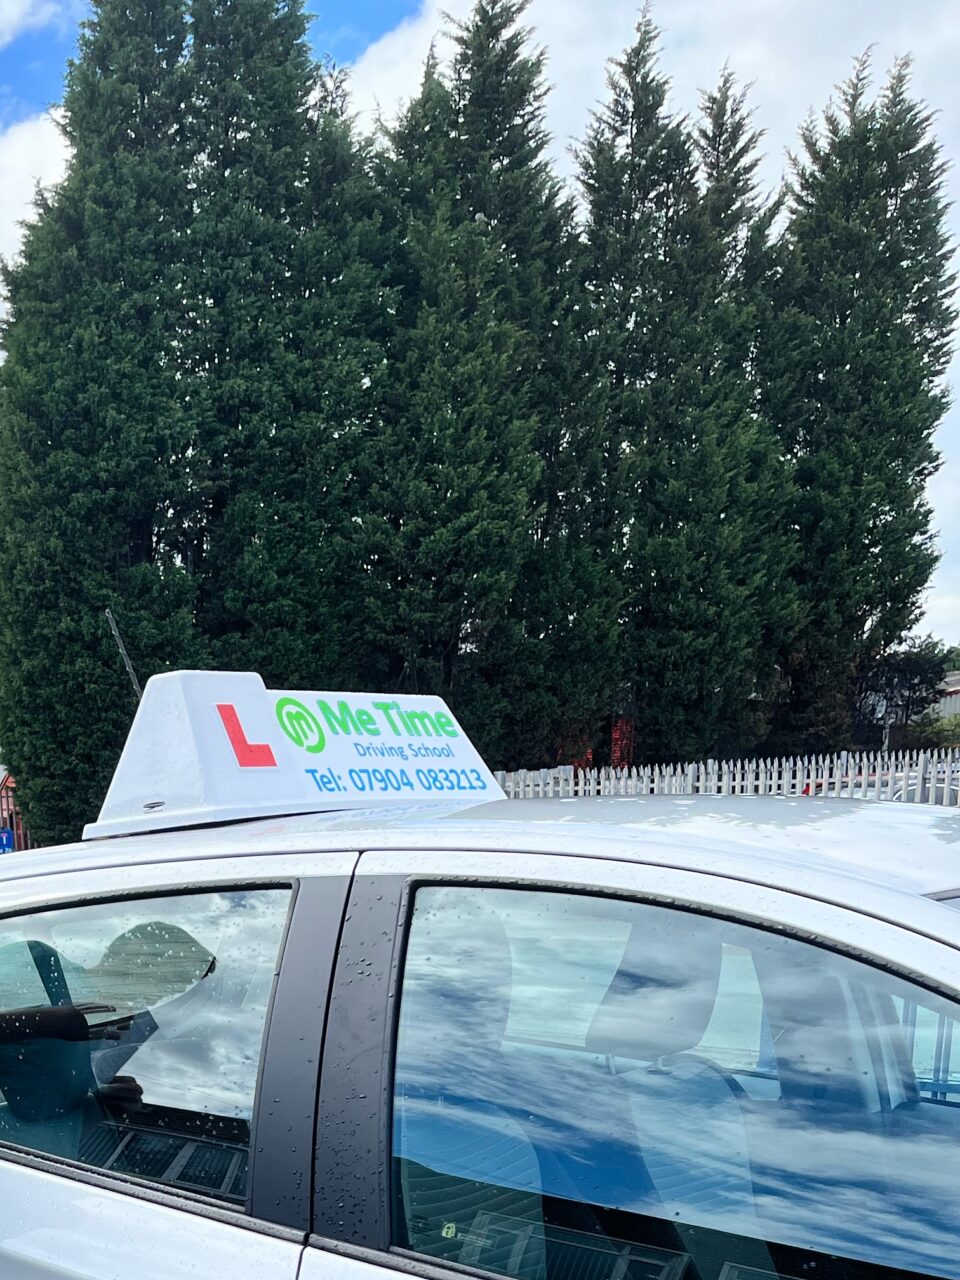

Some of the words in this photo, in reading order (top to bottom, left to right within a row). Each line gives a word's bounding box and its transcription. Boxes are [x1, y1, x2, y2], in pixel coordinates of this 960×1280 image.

[316, 699, 377, 736] Me
[373, 701, 459, 738] Time
[216, 703, 278, 767] L
[353, 742, 409, 761] Driving
[411, 743, 455, 758] School
[305, 768, 347, 793] Tel:
[348, 768, 414, 792] 07904
[416, 768, 487, 791] 083213
